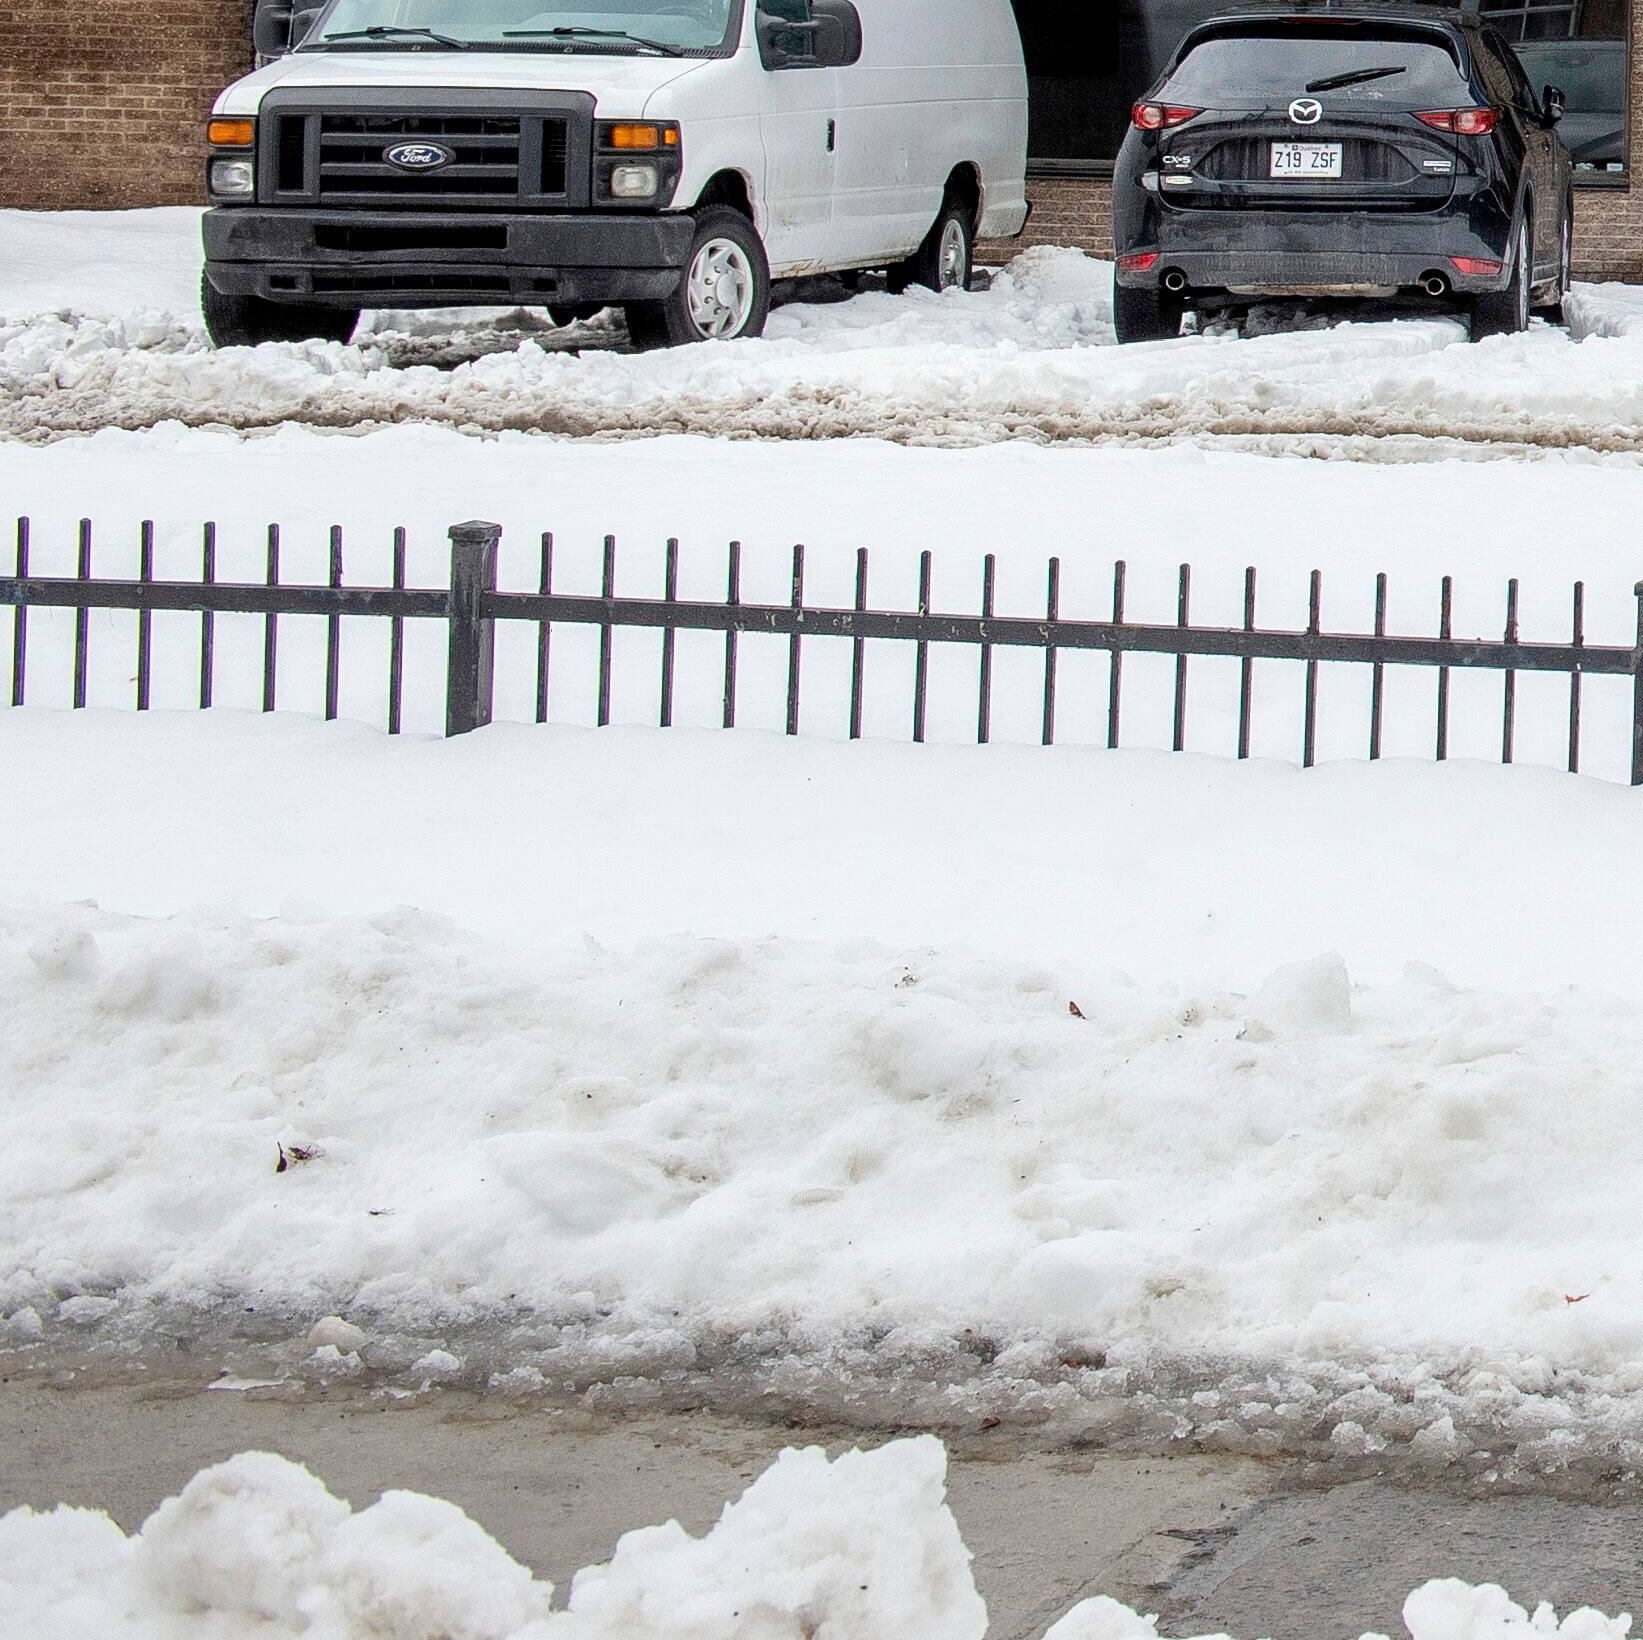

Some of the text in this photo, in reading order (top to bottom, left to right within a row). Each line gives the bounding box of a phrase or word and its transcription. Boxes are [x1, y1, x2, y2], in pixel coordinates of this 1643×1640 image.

[401, 148, 433, 163] Ford
[1275, 151, 1338, 168] Z19 ZSF
